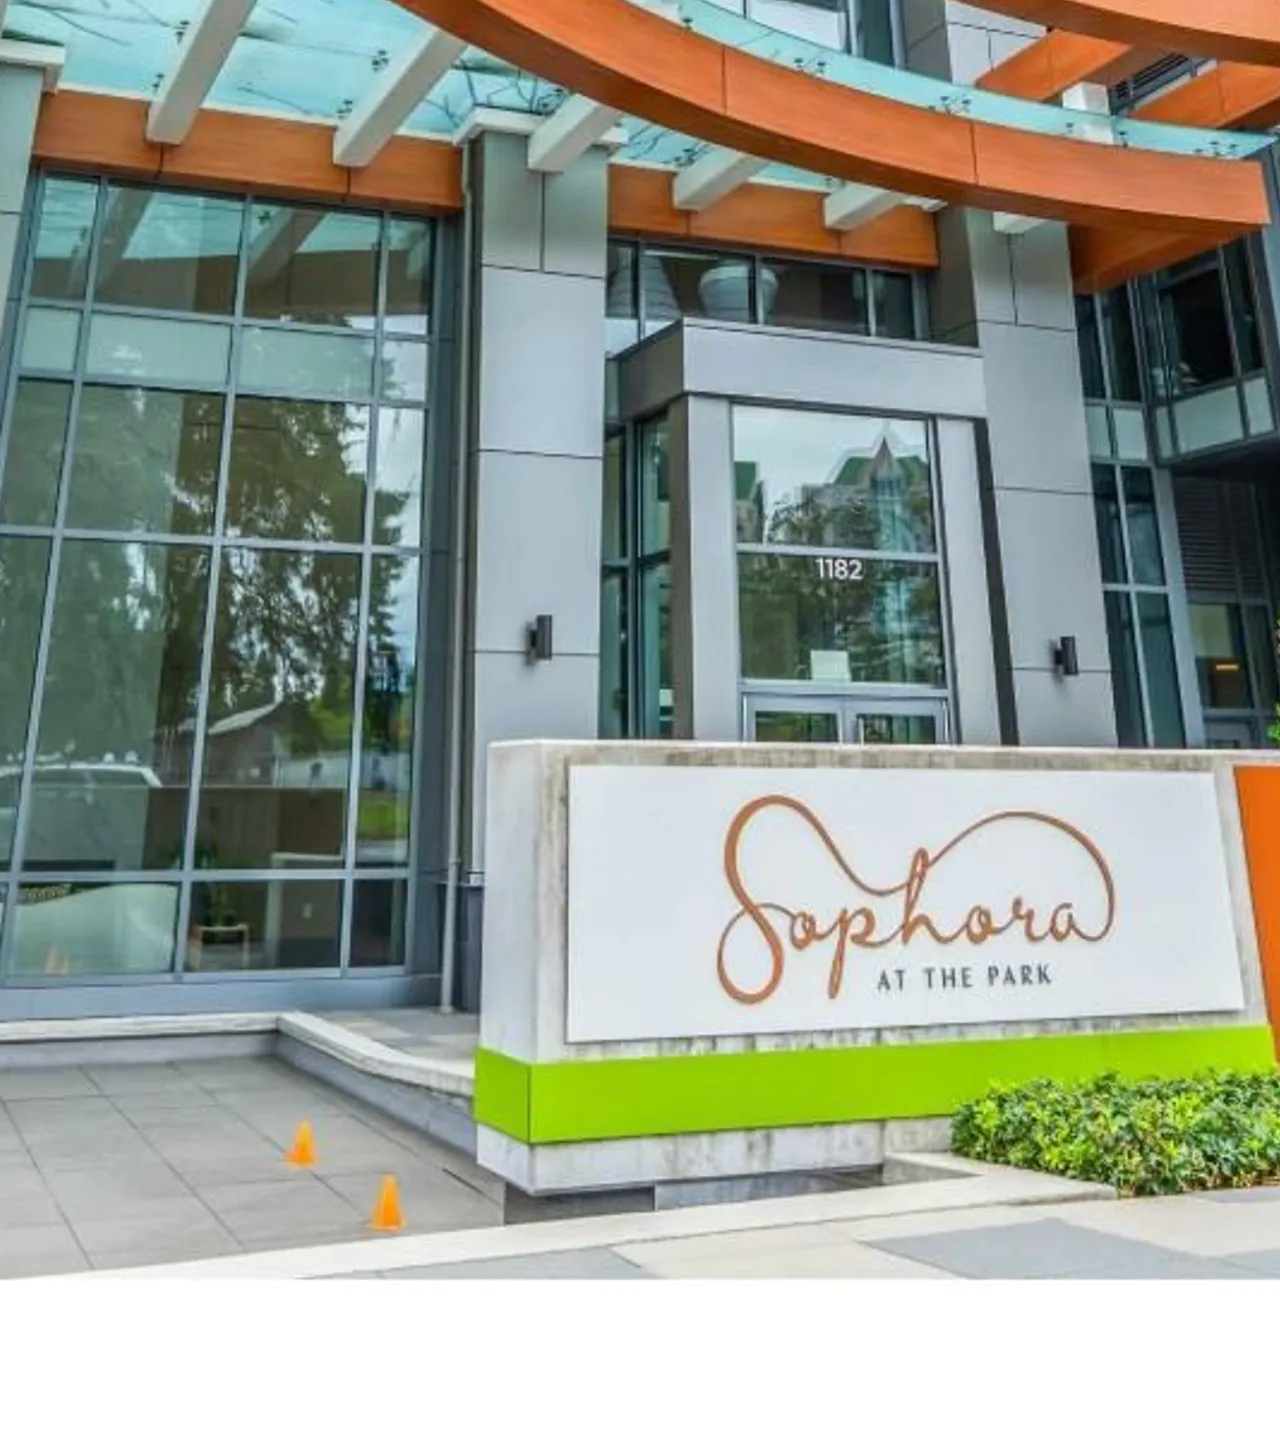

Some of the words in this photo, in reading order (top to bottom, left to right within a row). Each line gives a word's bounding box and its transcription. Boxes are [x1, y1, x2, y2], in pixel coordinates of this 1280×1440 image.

[816, 558, 864, 580] 1182
[718, 794, 1115, 1005] Sophora
[877, 969, 905, 991] AT
[923, 966, 974, 990] THE
[986, 963, 1052, 987] PARK
